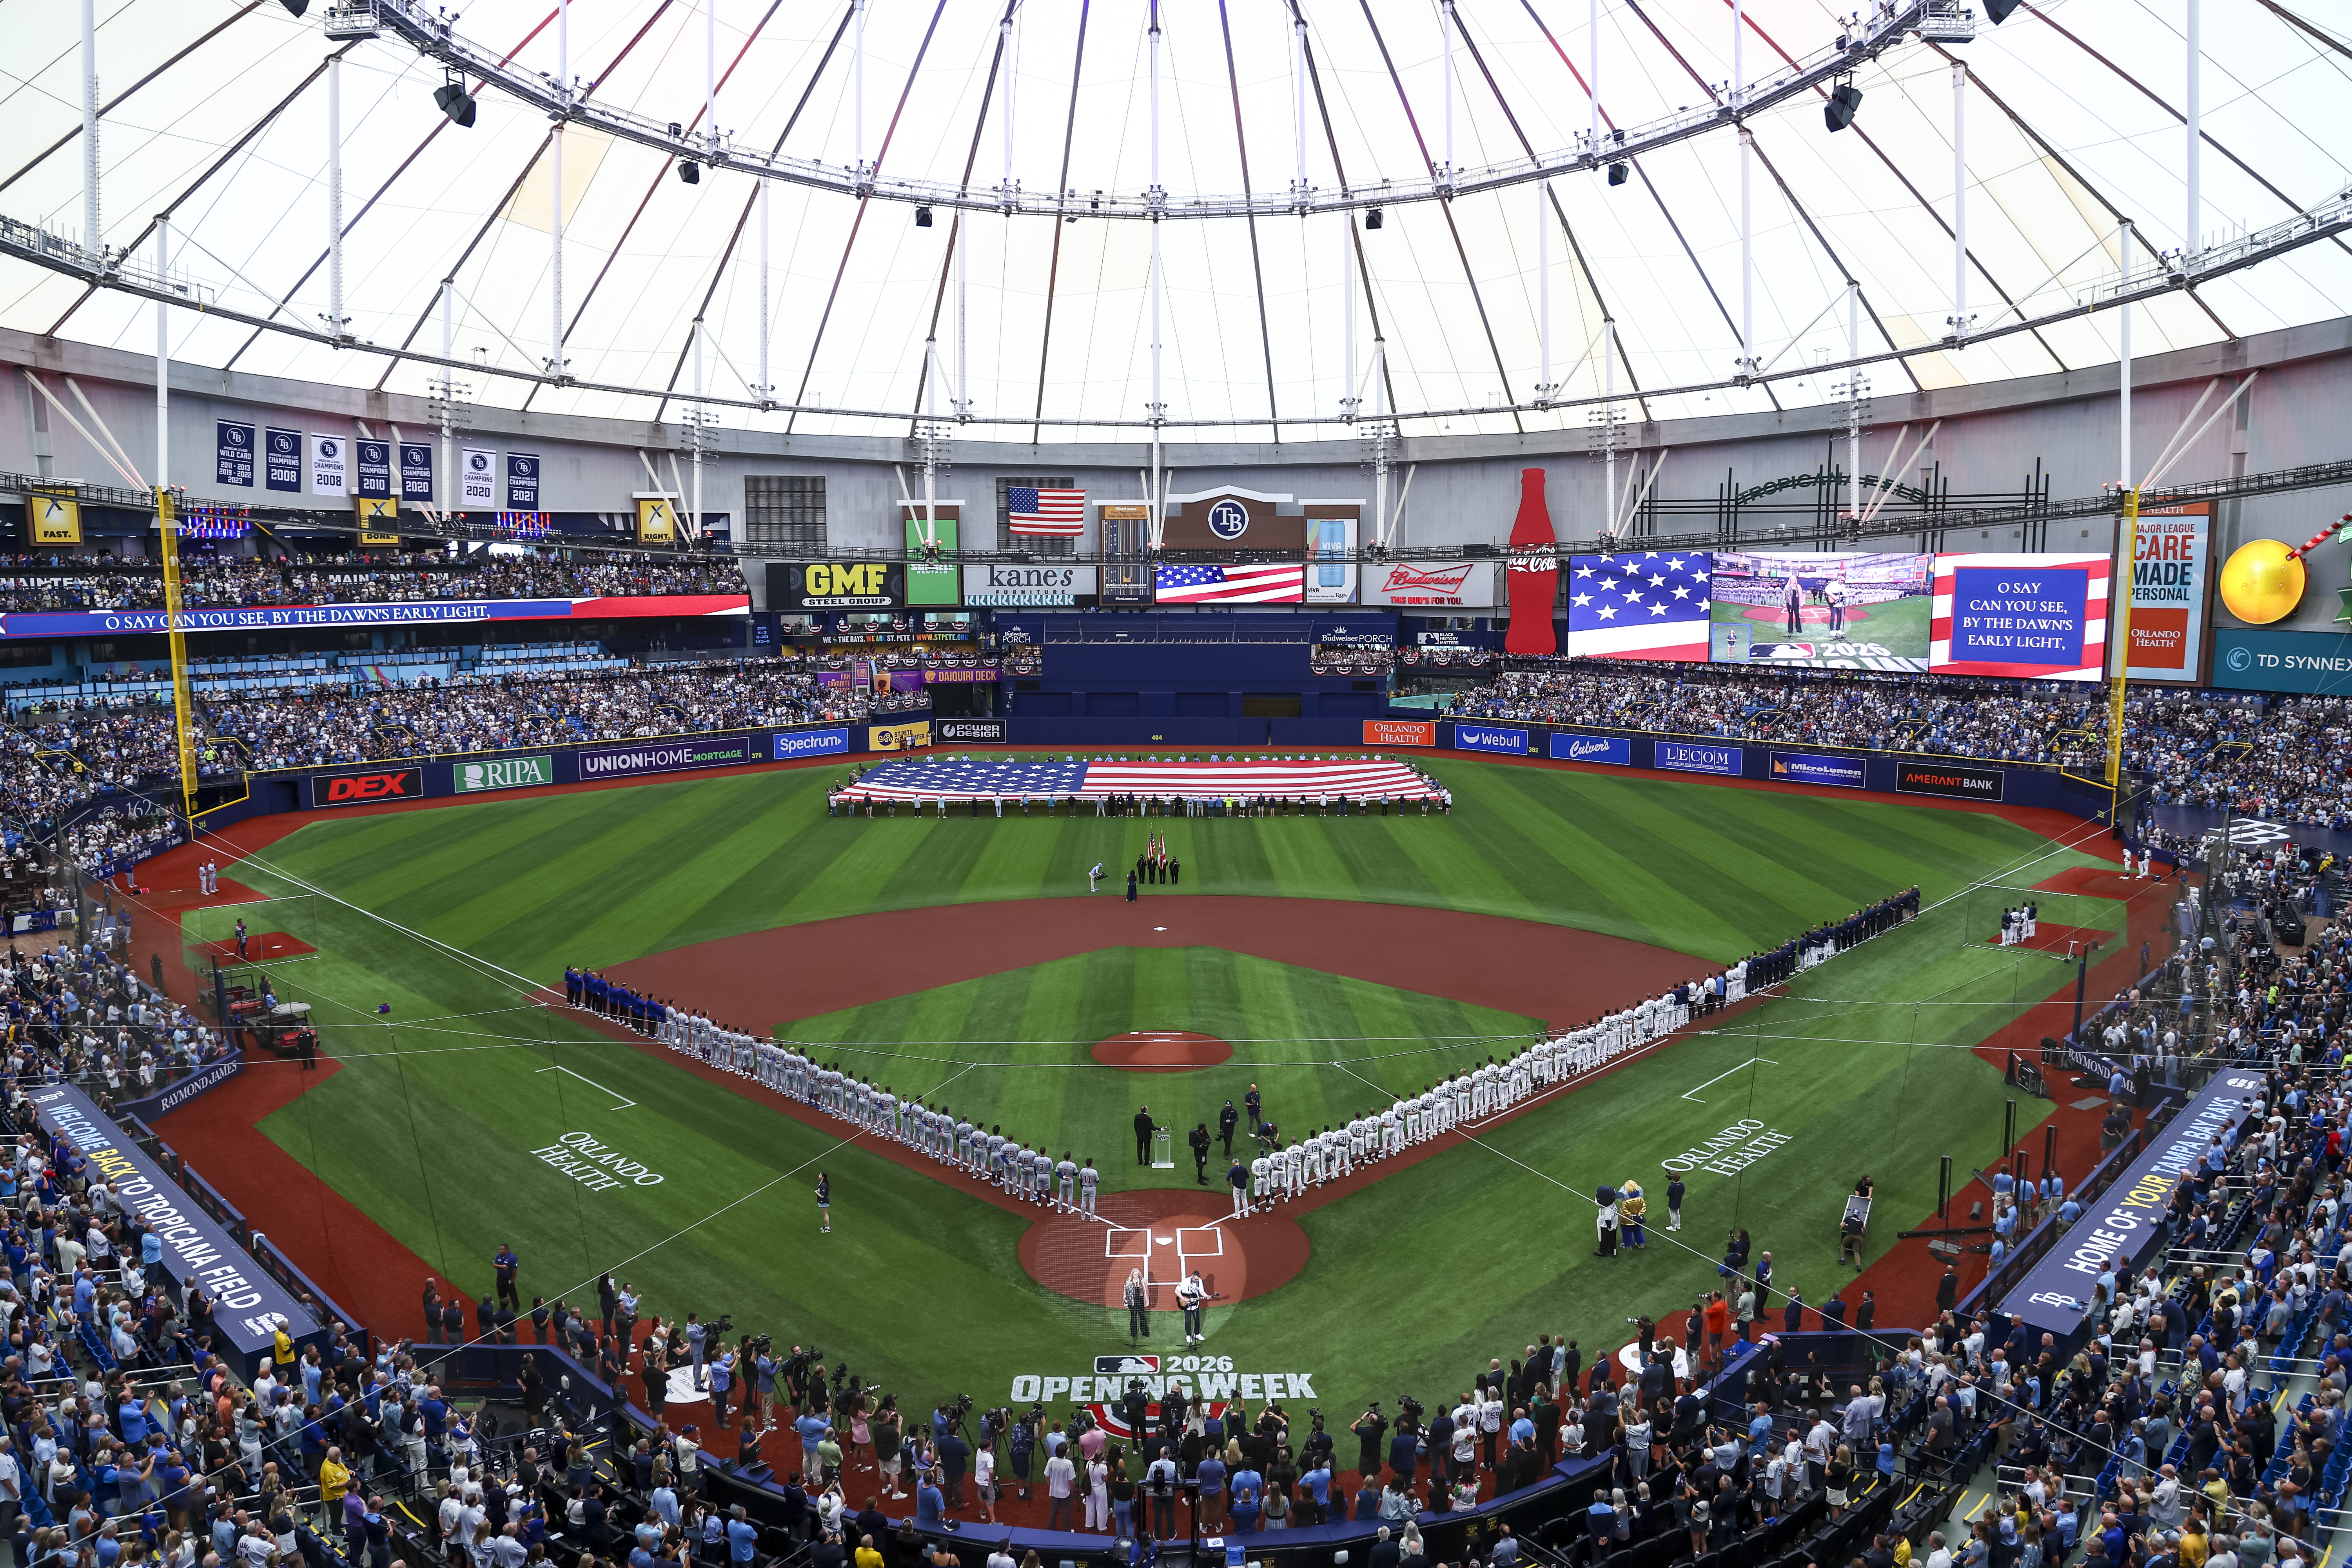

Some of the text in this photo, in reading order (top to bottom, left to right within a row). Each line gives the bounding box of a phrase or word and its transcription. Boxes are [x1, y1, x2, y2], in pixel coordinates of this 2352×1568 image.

[269, 456, 299, 466] CHAMPIONS
[314, 462, 343, 470] CHAMPIONS
[271, 468, 296, 482] 2008
[317, 474, 341, 486] 2008
[464, 474, 493, 483] CHAMPIONS
[363, 478, 385, 490] 2010
[406, 481, 429, 492] 2020
[466, 485, 490, 497] 2020
[1737, 472, 1926, 505] TROPICANA FELD
[513, 490, 534, 501] 2021
[1216, 507, 1242, 532] TB
[2136, 524, 2195, 533] MAJOR LEAGUE
[2134, 535, 2194, 560] CARE
[806, 564, 887, 595] GMF
[987, 565, 1073, 587] kane's
[1390, 571, 1464, 584] Budweiser
[2133, 563, 2193, 585] MADE
[1998, 583, 2042, 594] O SAY
[2132, 588, 2190, 601] PERSONAL
[1970, 600, 2067, 615] CAN YOU SEE,
[105, 605, 491, 630] O SAY CAN YOU SEE, BY THE DAWN'S EARLY LIGHT,
[1963, 617, 2073, 631] BY THE DAWN'S
[2131, 629, 2181, 638] ORLANDO
[1968, 635, 2065, 651] EARLY LIGHT,
[2136, 637, 2176, 647] HEALTH
[1820, 643, 1891, 657] 2026
[2257, 654, 2279, 667] TD
[939, 670, 996, 682] DAIQUIRI DECK
[1374, 723, 1425, 733] ORLANDO
[780, 736, 838, 753] Spectrum
[1380, 733, 1419, 743] HEALTH
[1482, 733, 1520, 748] Webull
[693, 749, 742, 762] MORTGAGE
[1570, 739, 1610, 758] Culver's
[485, 759, 544, 786] RIPA
[1791, 763, 1861, 775] MicroLumen
[328, 773, 408, 800] DEX
[1906, 773, 1993, 790] AMERANT BANK
[2178, 858, 2189, 867] RIPA
[2068, 1048, 2111, 1079] RAYMOND
[161, 1059, 238, 1111] RAYMOND JAMES
[1661, 1119, 1764, 1171] ORLANDO
[559, 1132, 664, 1185] ORLANDO
[1701, 1131, 1793, 1177] HEALTH
[530, 1144, 621, 1192] HEALTH
[2063, 1096, 2241, 1275] HOME OF YOUR TAMPA BAY RAYS
[46, 1103, 262, 1309] WELCOME BACK TO TROPICANA FIELD
[1166, 1355, 1233, 1373] 2026
[1197, 1373, 1318, 1400] WEEK
